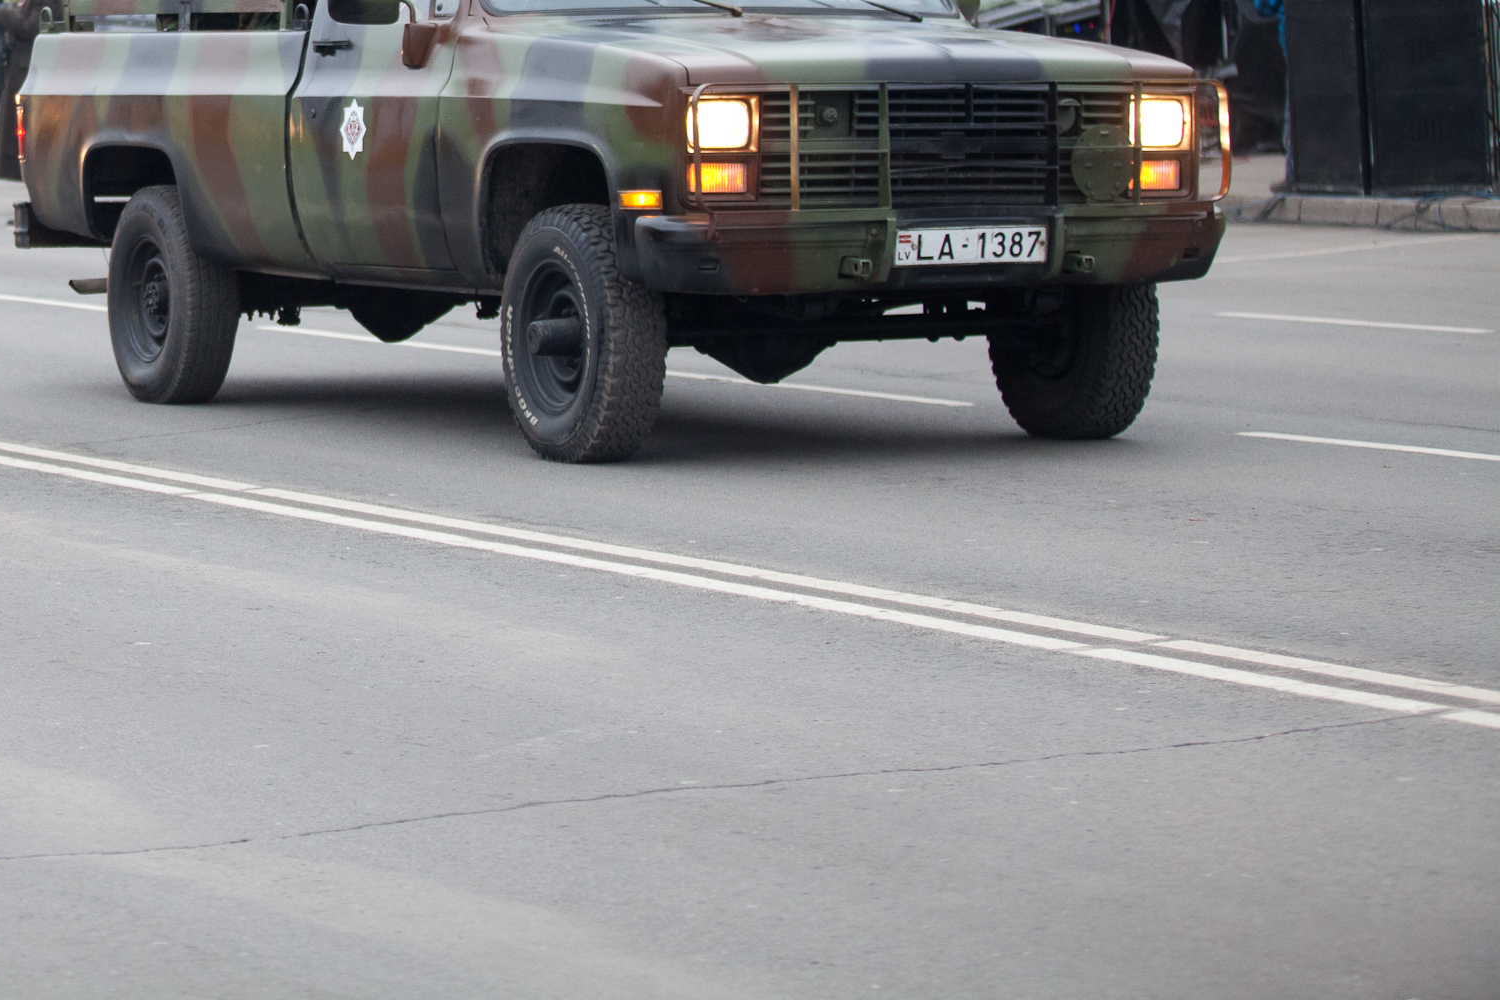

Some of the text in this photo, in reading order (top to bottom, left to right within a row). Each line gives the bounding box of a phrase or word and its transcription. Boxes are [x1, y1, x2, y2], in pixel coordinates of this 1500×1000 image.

[897, 230, 1042, 261] LV LA-1387
[506, 304, 539, 427] BFGoodrich
